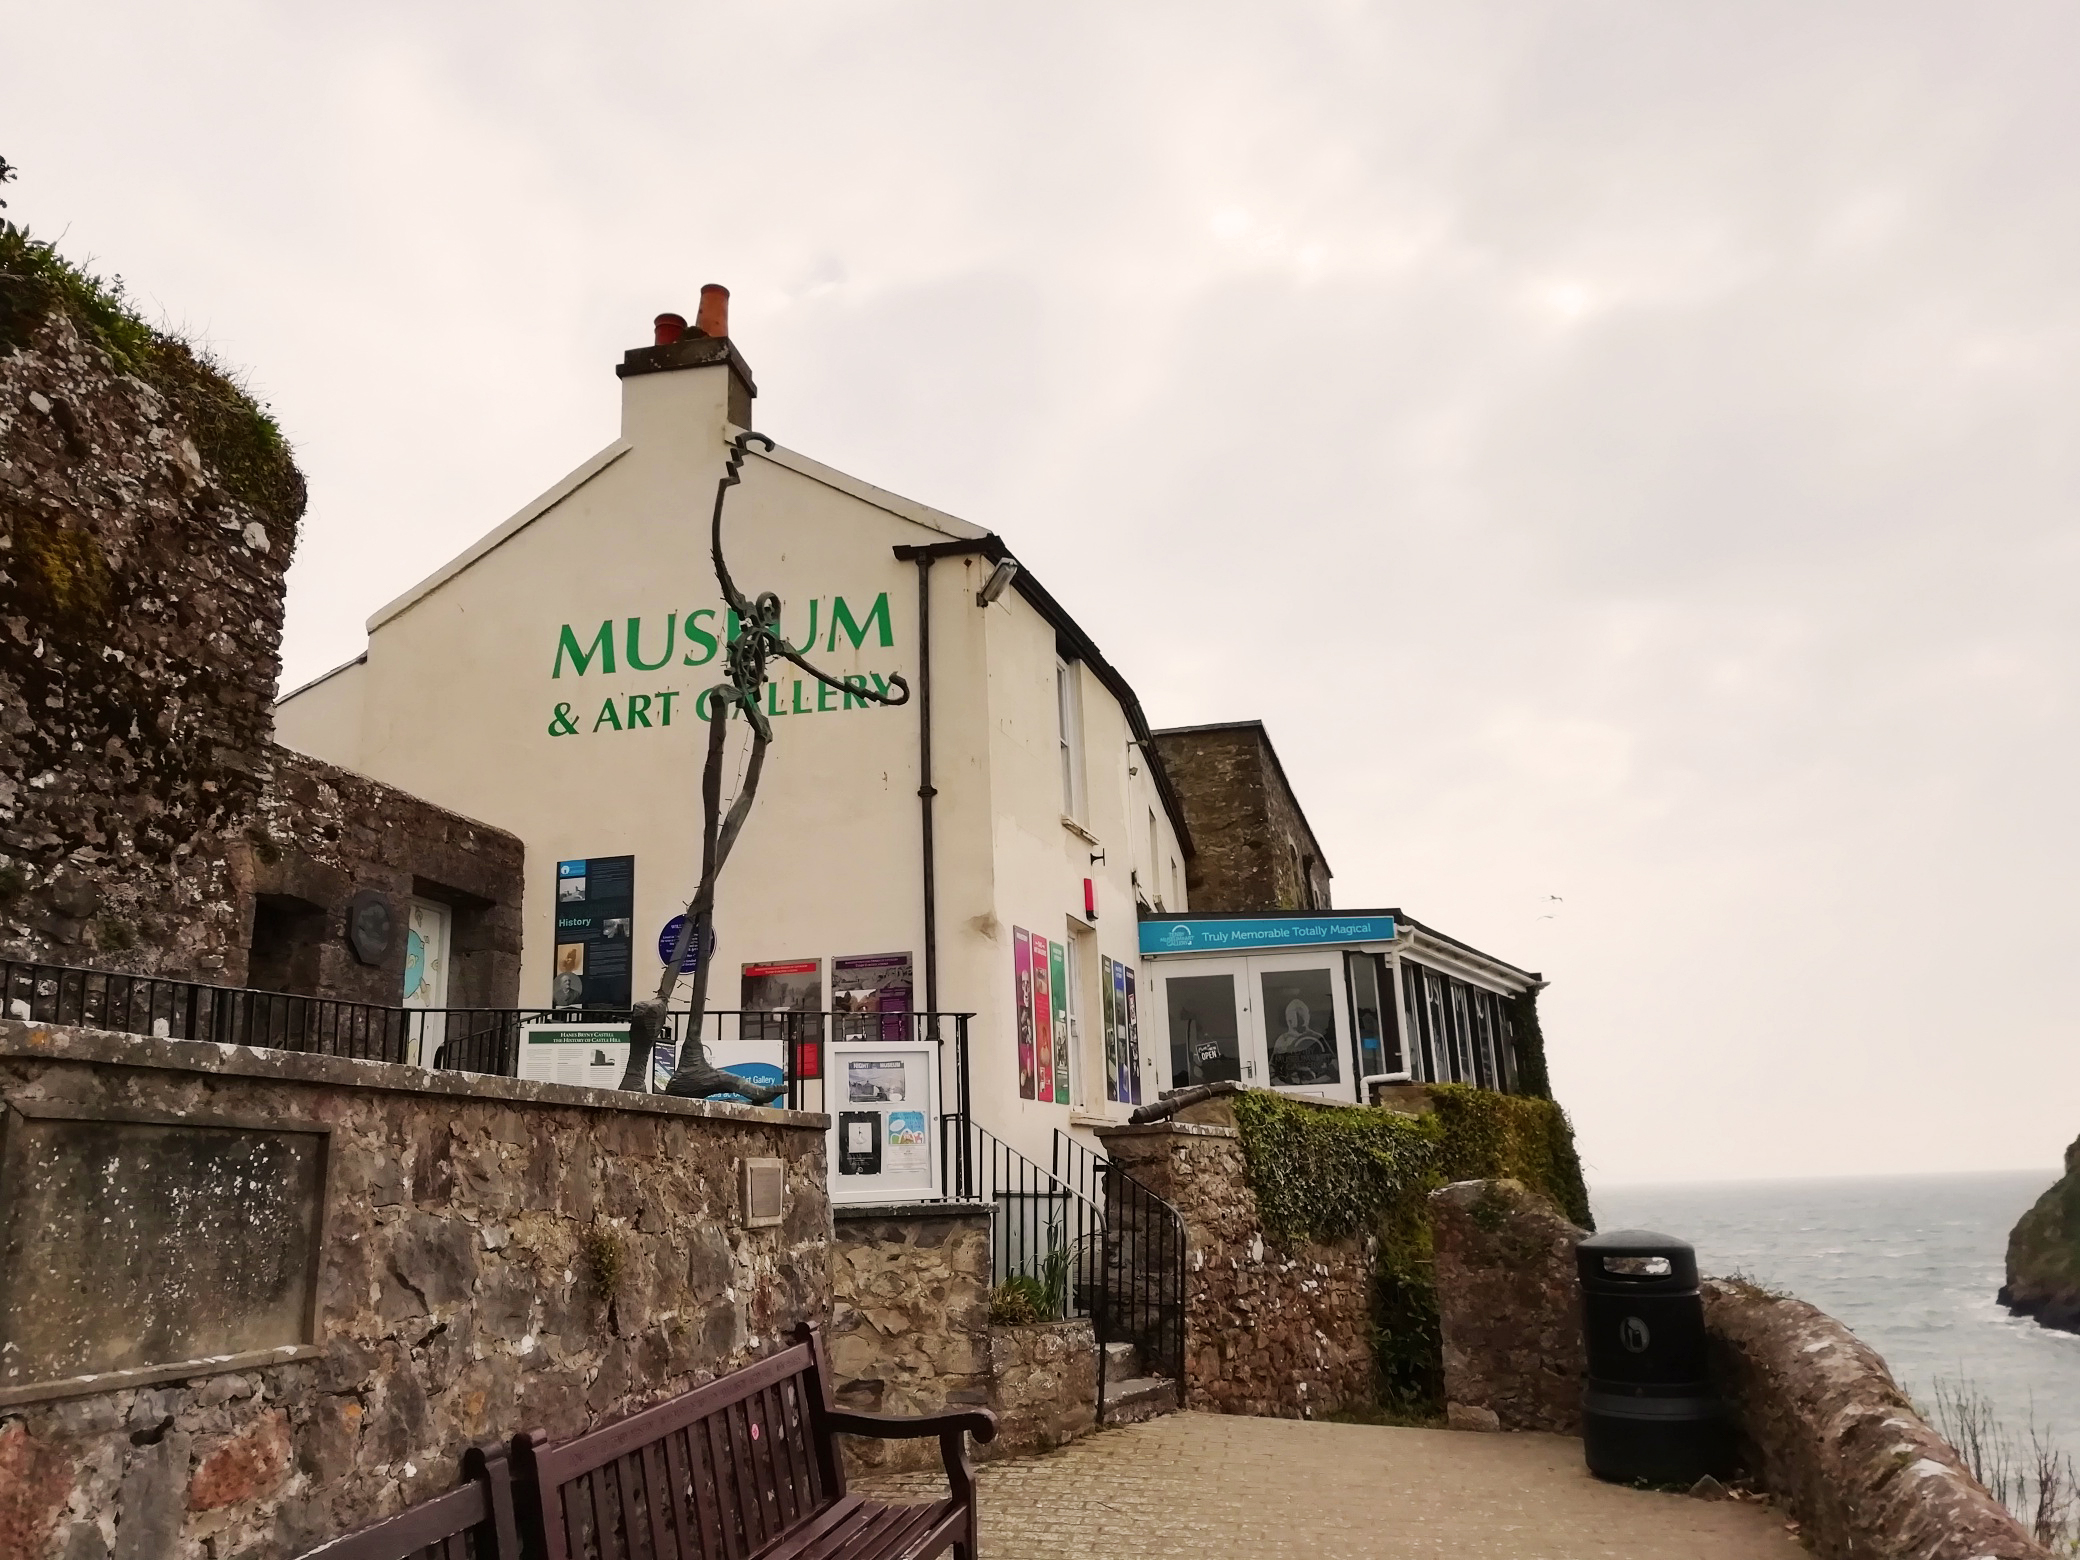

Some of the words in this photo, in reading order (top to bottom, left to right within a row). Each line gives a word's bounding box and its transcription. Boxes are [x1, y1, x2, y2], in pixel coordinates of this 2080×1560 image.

[547, 701, 581, 738] &
[592, 690, 681, 734] ART
[695, 672, 898, 723] GLLERY
[558, 918, 592, 928] History
[1202, 931, 1229, 943] Truly
[1231, 928, 1290, 941] Memorable
[1292, 926, 1328, 938] Totally
[1330, 923, 1372, 936] Magical
[1201, 1050, 1217, 1061] OPEN
[753, 1075, 776, 1085] Gallery
